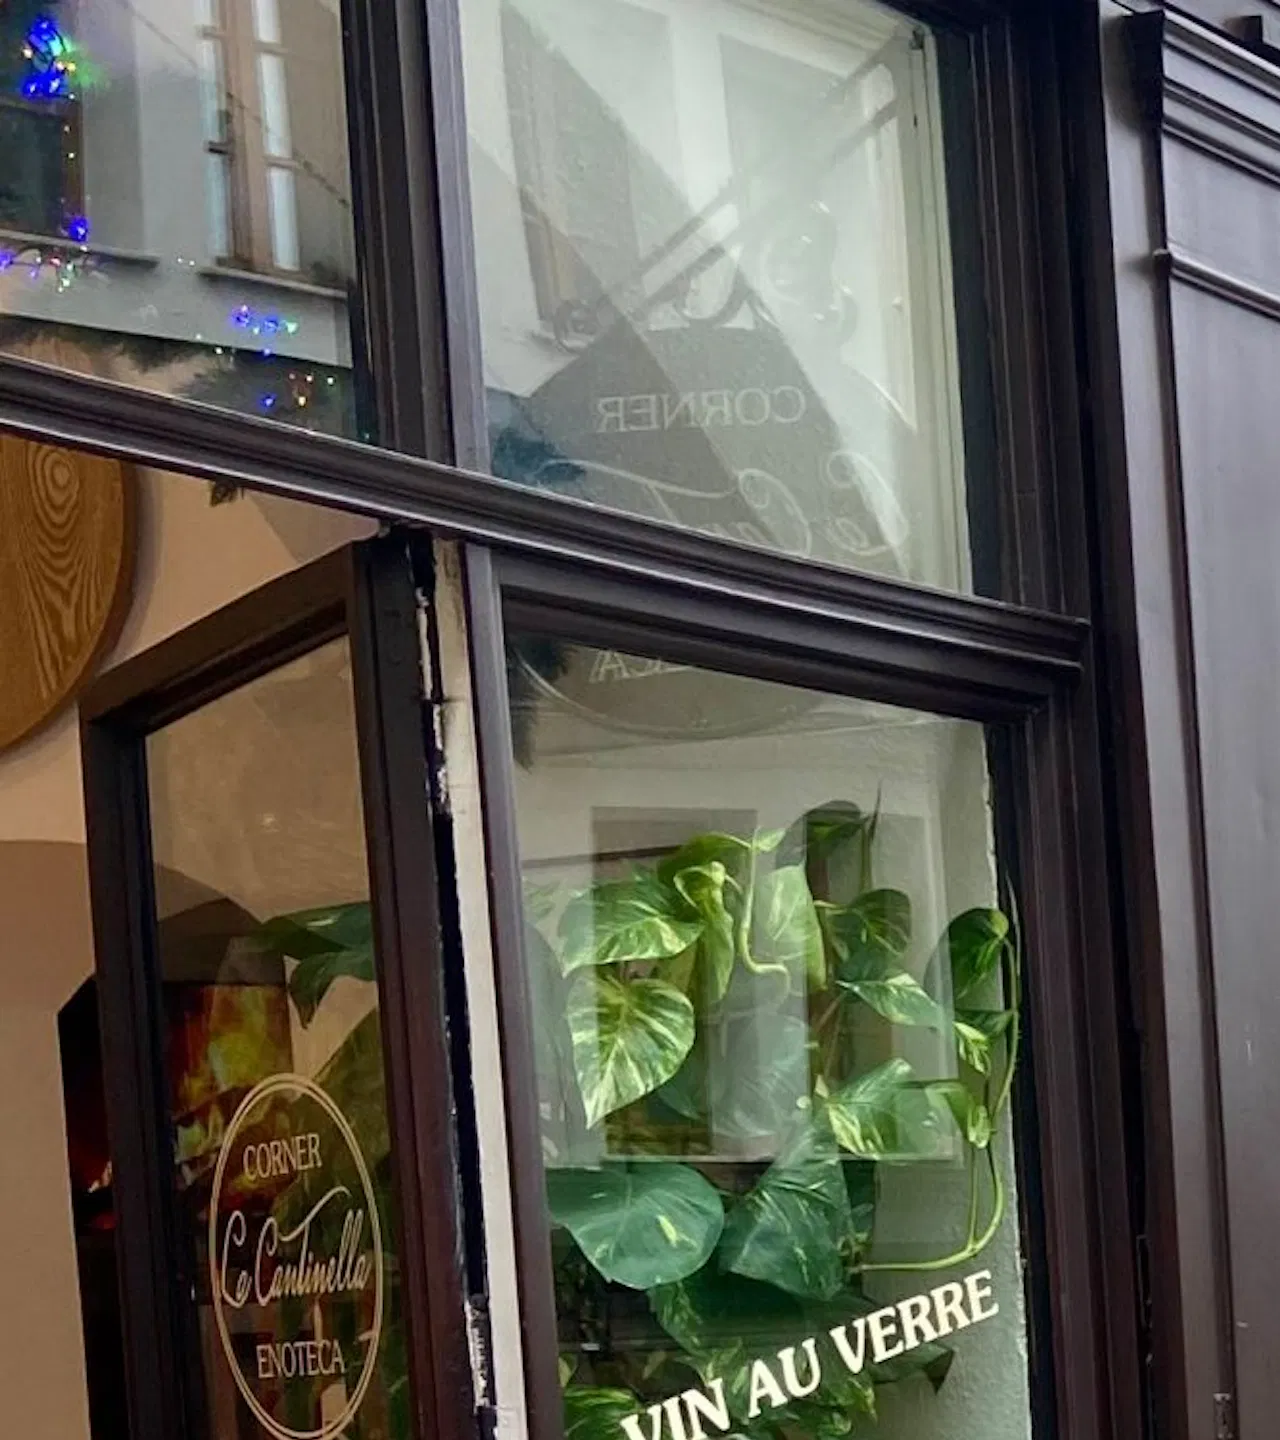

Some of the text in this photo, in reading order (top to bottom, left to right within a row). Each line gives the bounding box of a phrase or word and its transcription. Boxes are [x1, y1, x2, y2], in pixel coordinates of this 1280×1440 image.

[242, 1133, 322, 1180] CORNER
[221, 1185, 373, 1309] La Cantinella
[257, 1339, 347, 1380] ENOTECA
[748, 1338, 821, 1419] AU
[829, 1269, 1000, 1375] VERRE
